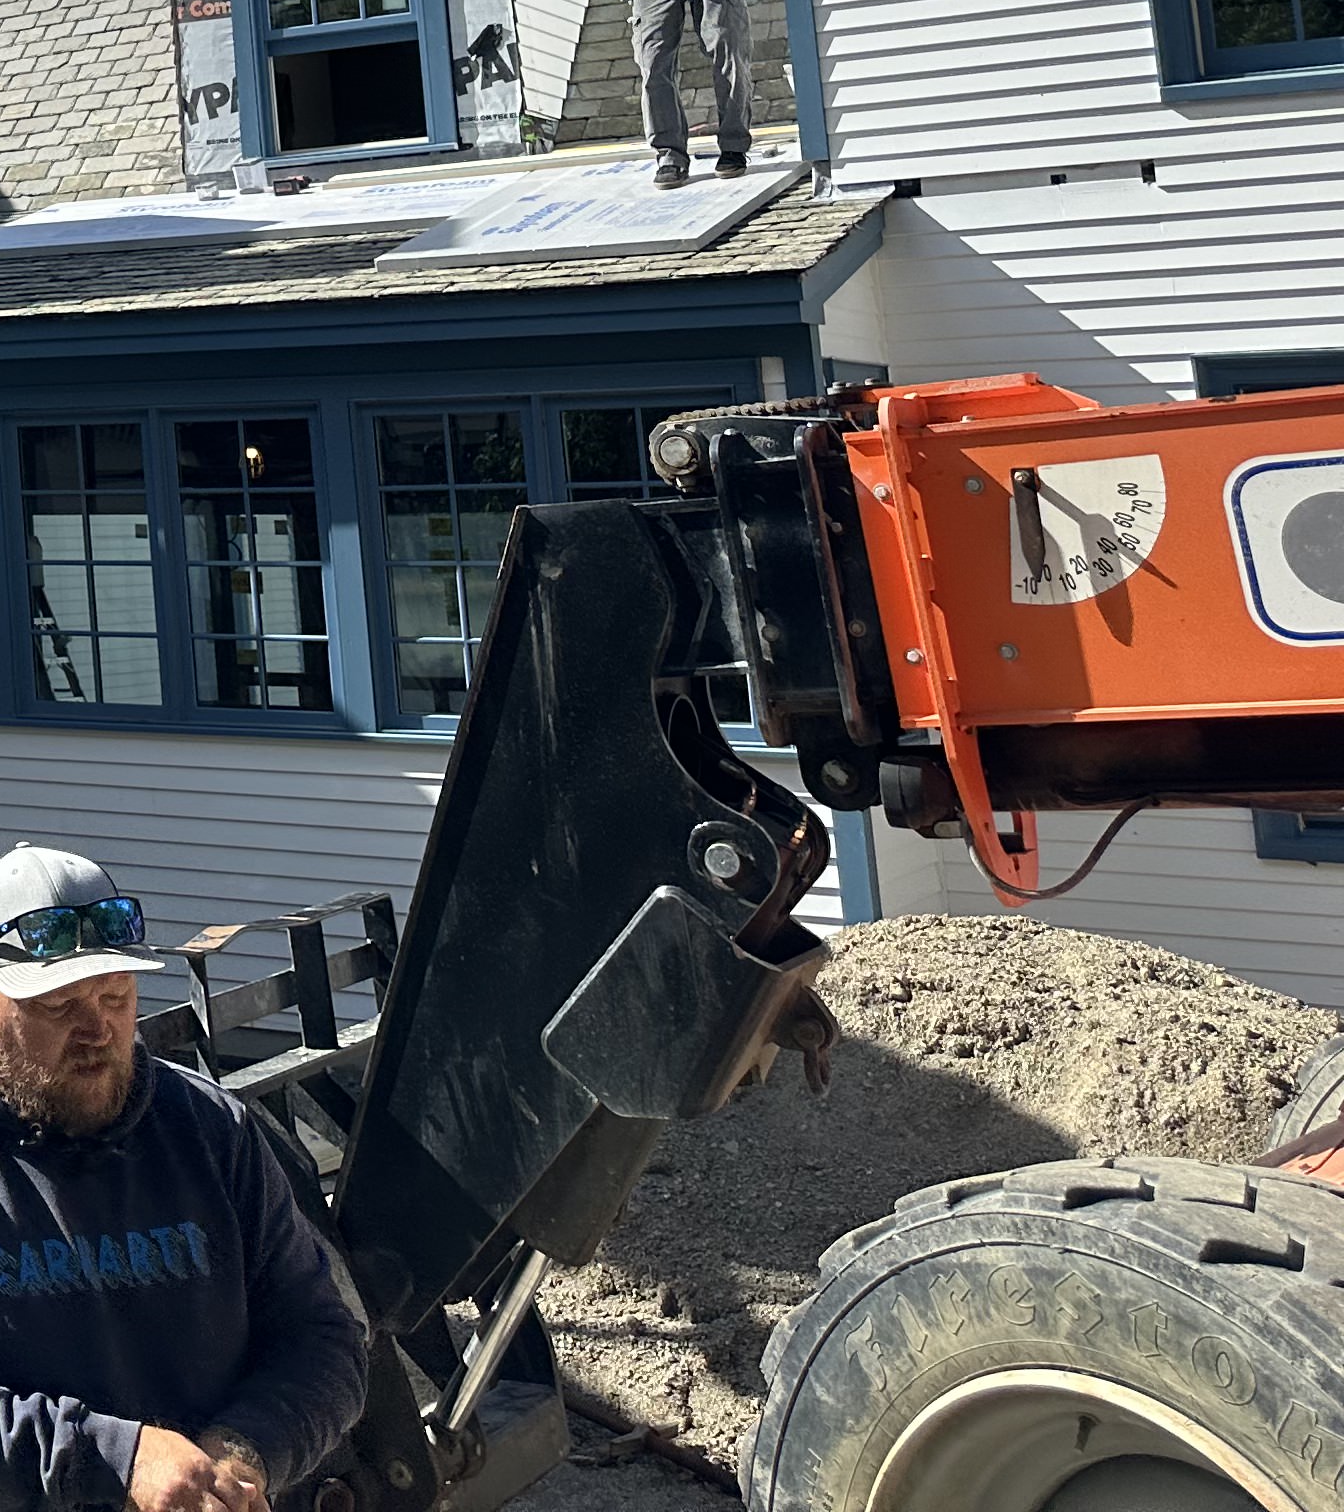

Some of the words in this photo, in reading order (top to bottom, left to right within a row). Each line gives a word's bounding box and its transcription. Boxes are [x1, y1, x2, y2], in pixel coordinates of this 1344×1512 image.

[1117, 482, 1139, 497] 80
[1131, 499, 1153, 515] 70
[1112, 511, 1136, 529] 60
[1096, 537, 1118, 555] 40
[1117, 532, 1141, 551] 50
[1069, 554, 1089, 576] 20
[1092, 557, 1114, 577] 30
[1014, 576, 1039, 595] -10
[1059, 572, 1077, 592] 10
